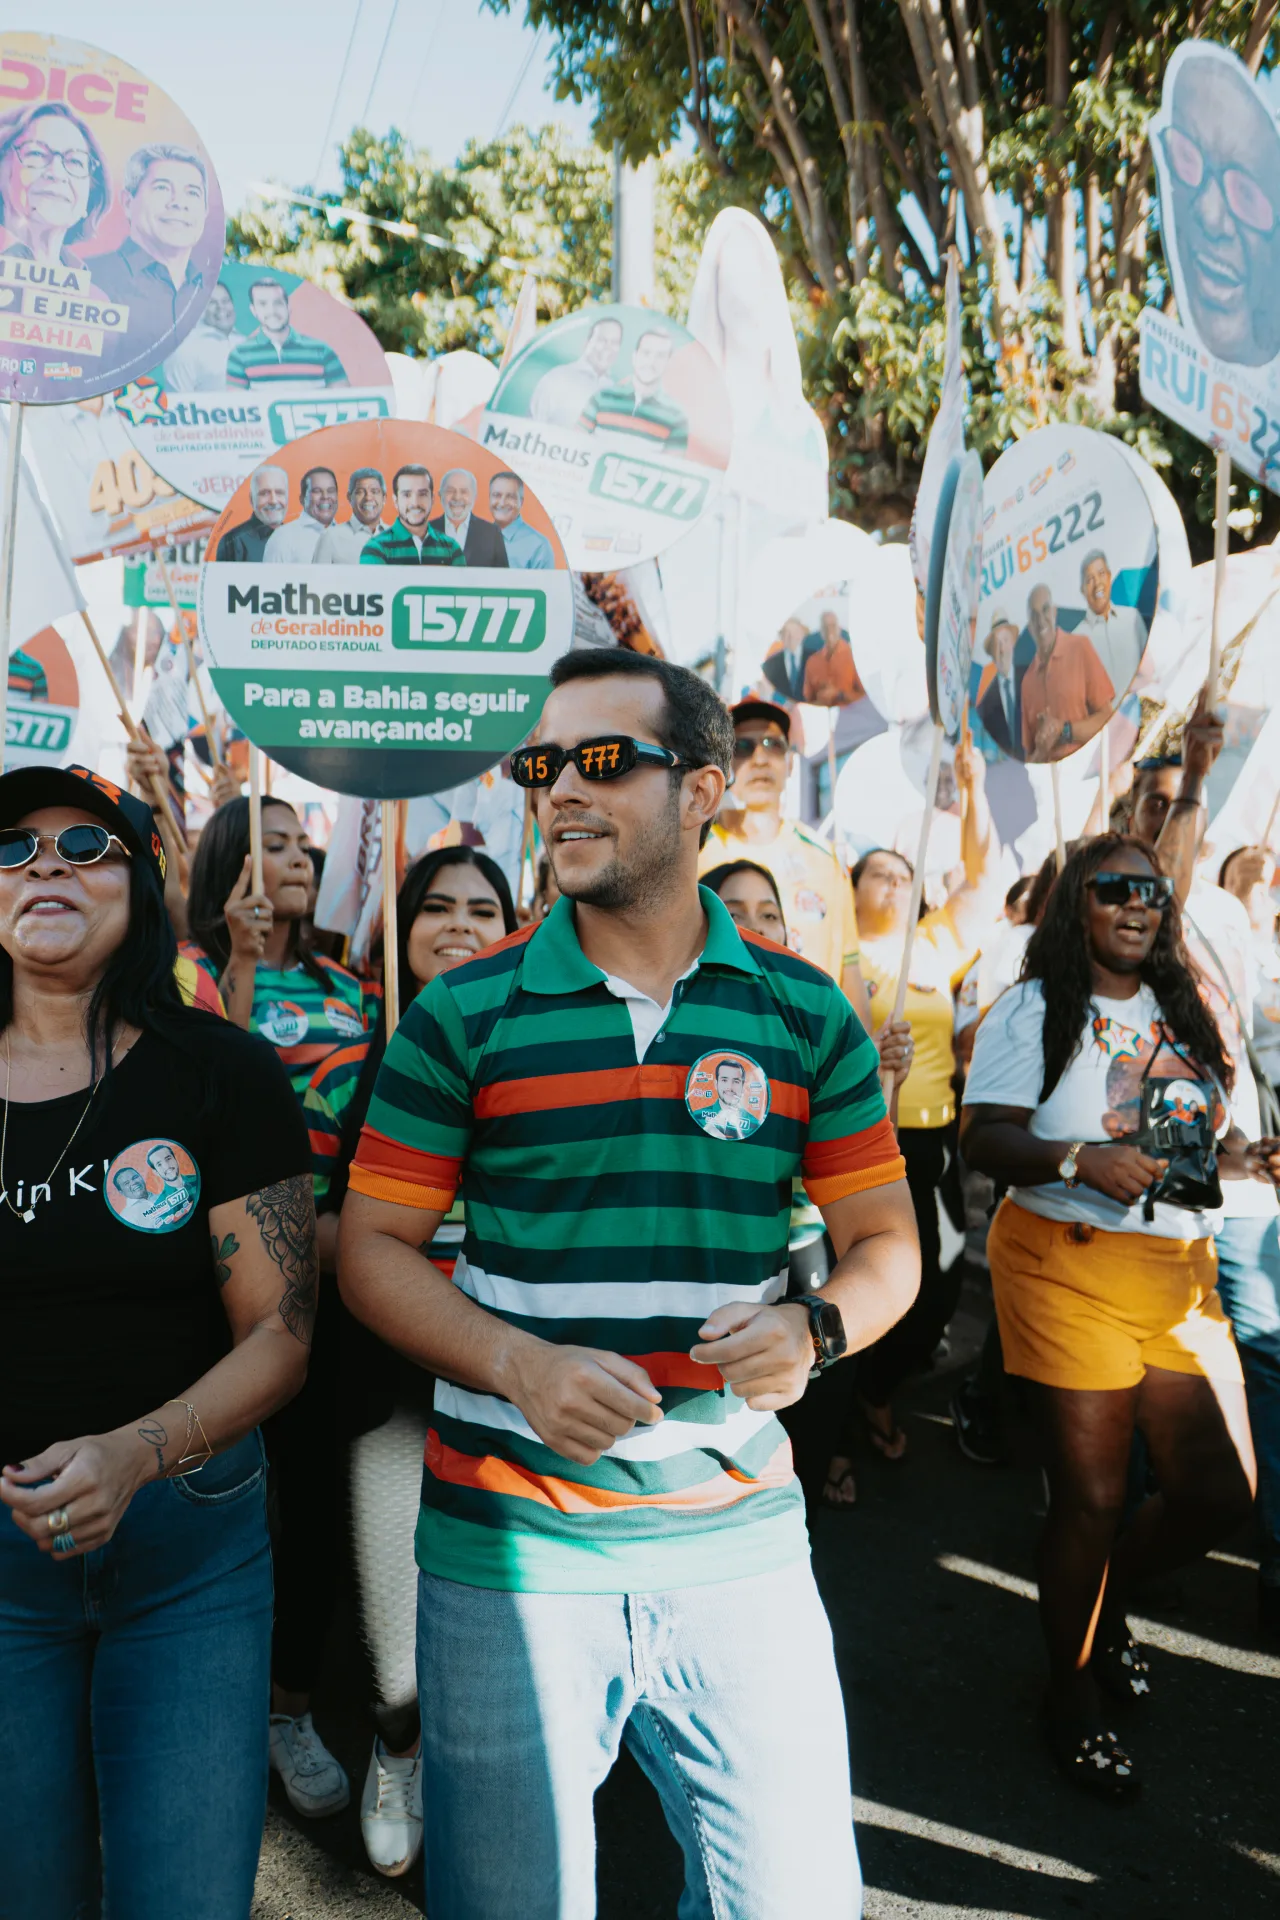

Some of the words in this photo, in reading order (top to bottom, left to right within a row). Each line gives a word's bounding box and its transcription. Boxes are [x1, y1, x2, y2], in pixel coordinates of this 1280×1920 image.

[0, 58, 149, 123] DICE
[14, 262, 80, 291] LULA
[33, 295, 49, 315] E
[55, 300, 121, 326] JERO
[9, 320, 93, 351] BAHIA
[152, 401, 262, 427] atheus
[483, 424, 592, 468] Matheus
[1016, 489, 1105, 574] 65222
[227, 582, 385, 617] Matheus
[403, 593, 536, 644] 15777
[251, 617, 273, 635] de
[274, 617, 385, 637] Geraldinho
[250, 639, 318, 651] DEPUTADO
[319, 640, 383, 652] ESTADUAL
[244, 682, 311, 708] Para
[317, 688, 336, 708] a
[343, 684, 428, 711] Bahia
[434, 687, 530, 716] seguir
[298, 716, 473, 745] avançando!
[524, 755, 548, 780] 15
[581, 743, 620, 773] 777
